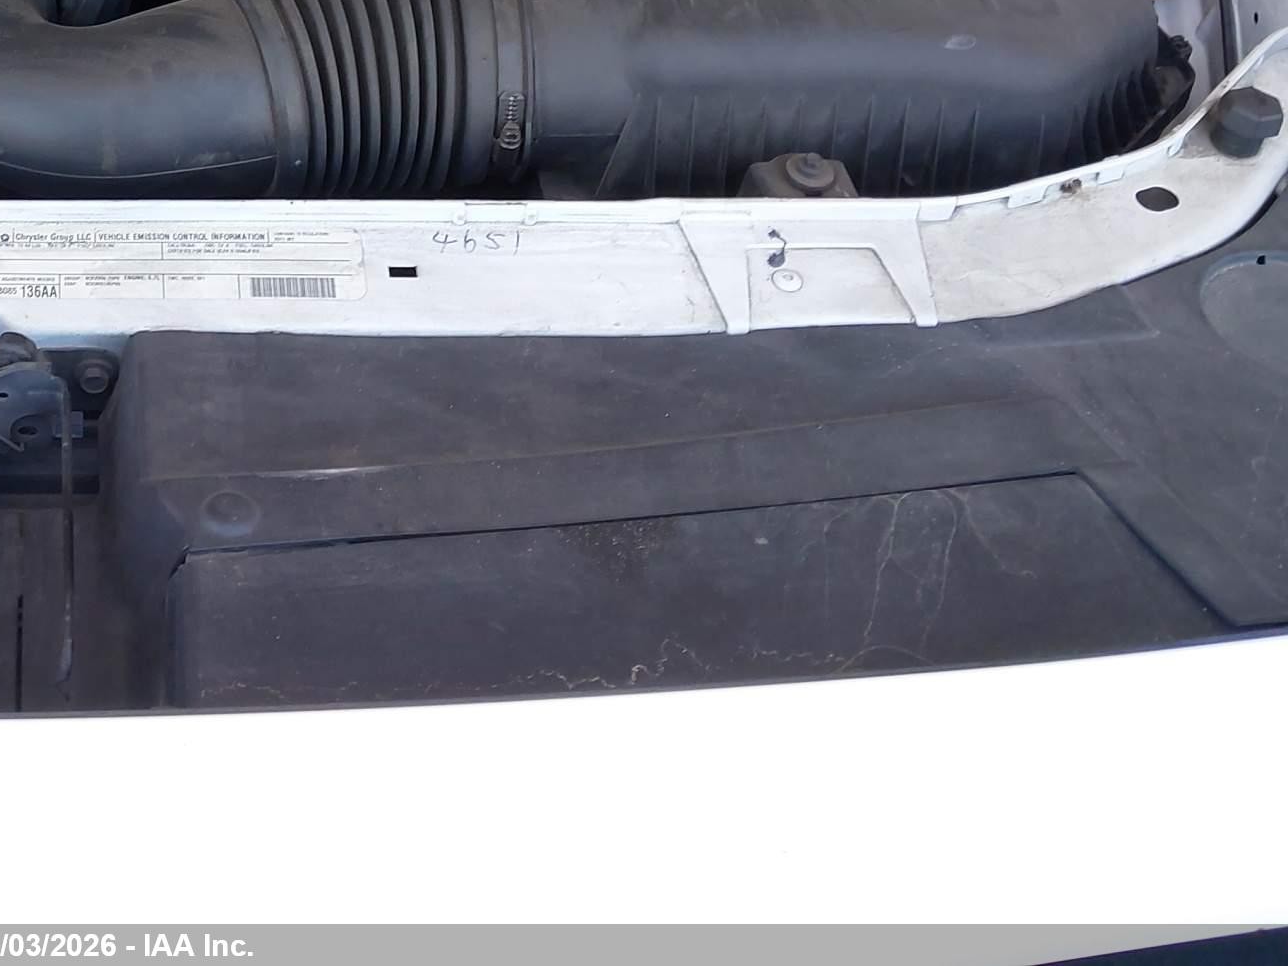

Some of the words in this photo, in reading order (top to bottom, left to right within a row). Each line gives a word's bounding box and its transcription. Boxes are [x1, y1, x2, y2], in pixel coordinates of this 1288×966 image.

[15, 233, 48, 243] Chrysler
[50, 233, 73, 244] Group
[76, 233, 92, 241] LLC
[98, 233, 130, 241] VEHICLE
[132, 233, 170, 241] EMISSION
[172, 233, 209, 241] CONTROL
[211, 233, 265, 241] INFORMATION
[431, 228, 520, 256] 4651
[21, 285, 58, 298] 136AA
